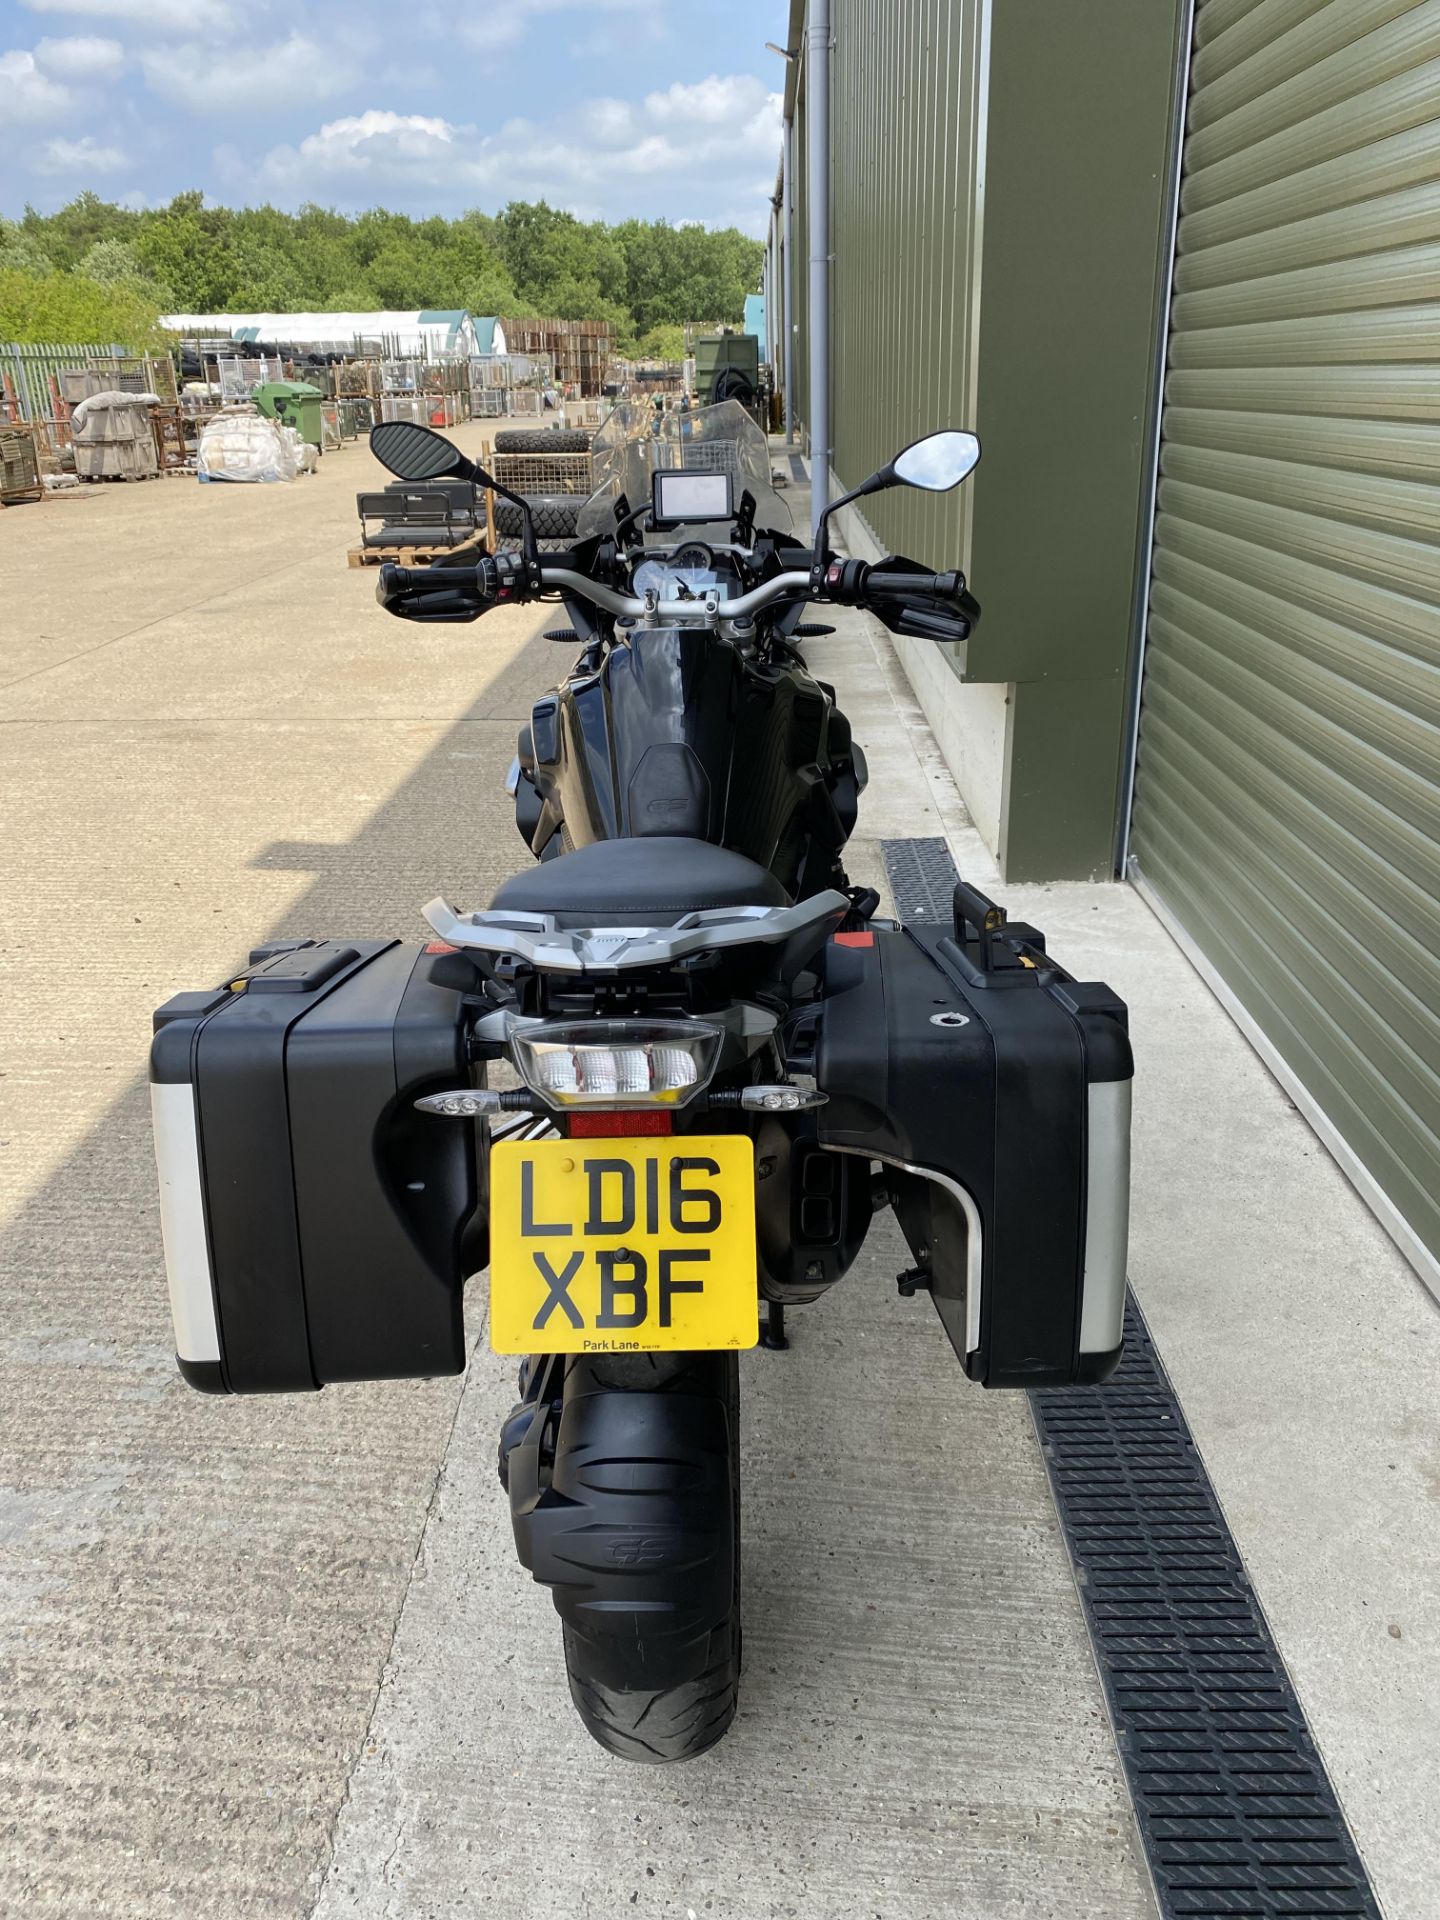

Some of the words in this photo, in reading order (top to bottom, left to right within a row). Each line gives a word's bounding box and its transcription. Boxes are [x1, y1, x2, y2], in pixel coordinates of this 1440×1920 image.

[521, 1157, 722, 1237] LD16
[532, 1249, 711, 1330] XBF
[583, 1340, 609, 1351] Park
[611, 1340, 640, 1350] Lane
